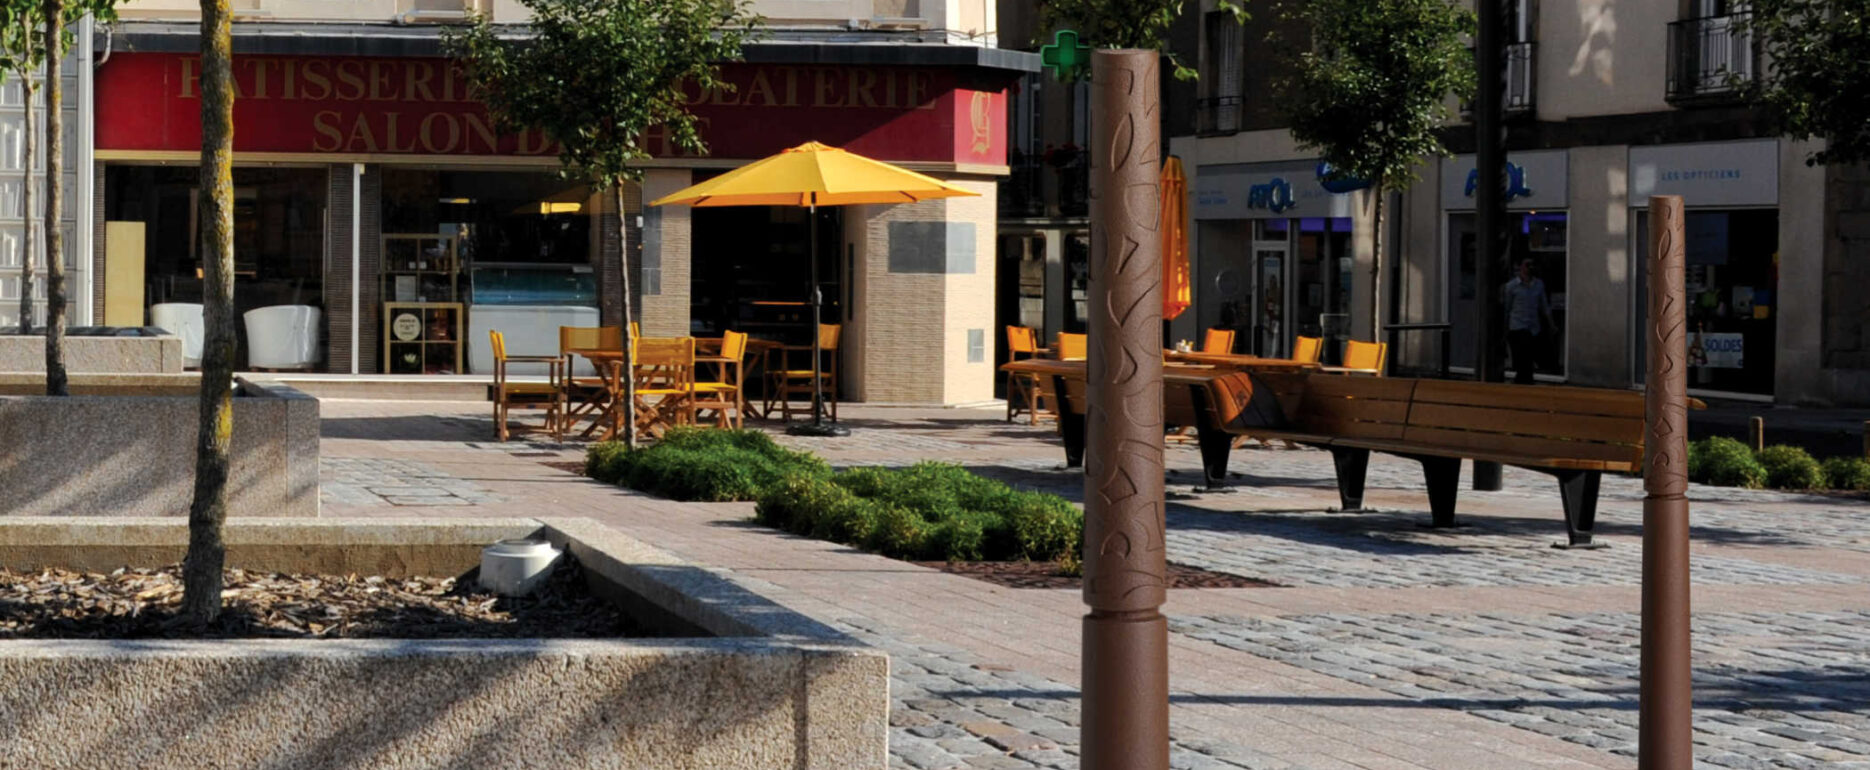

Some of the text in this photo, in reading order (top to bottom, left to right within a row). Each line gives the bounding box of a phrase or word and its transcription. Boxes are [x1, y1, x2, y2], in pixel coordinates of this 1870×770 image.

[313, 110, 502, 155] SALON
[1661, 169, 1741, 181] LES OPTICIENS
[1247, 177, 1297, 214] ATOL
[1704, 338, 1742, 353] SOLDES
